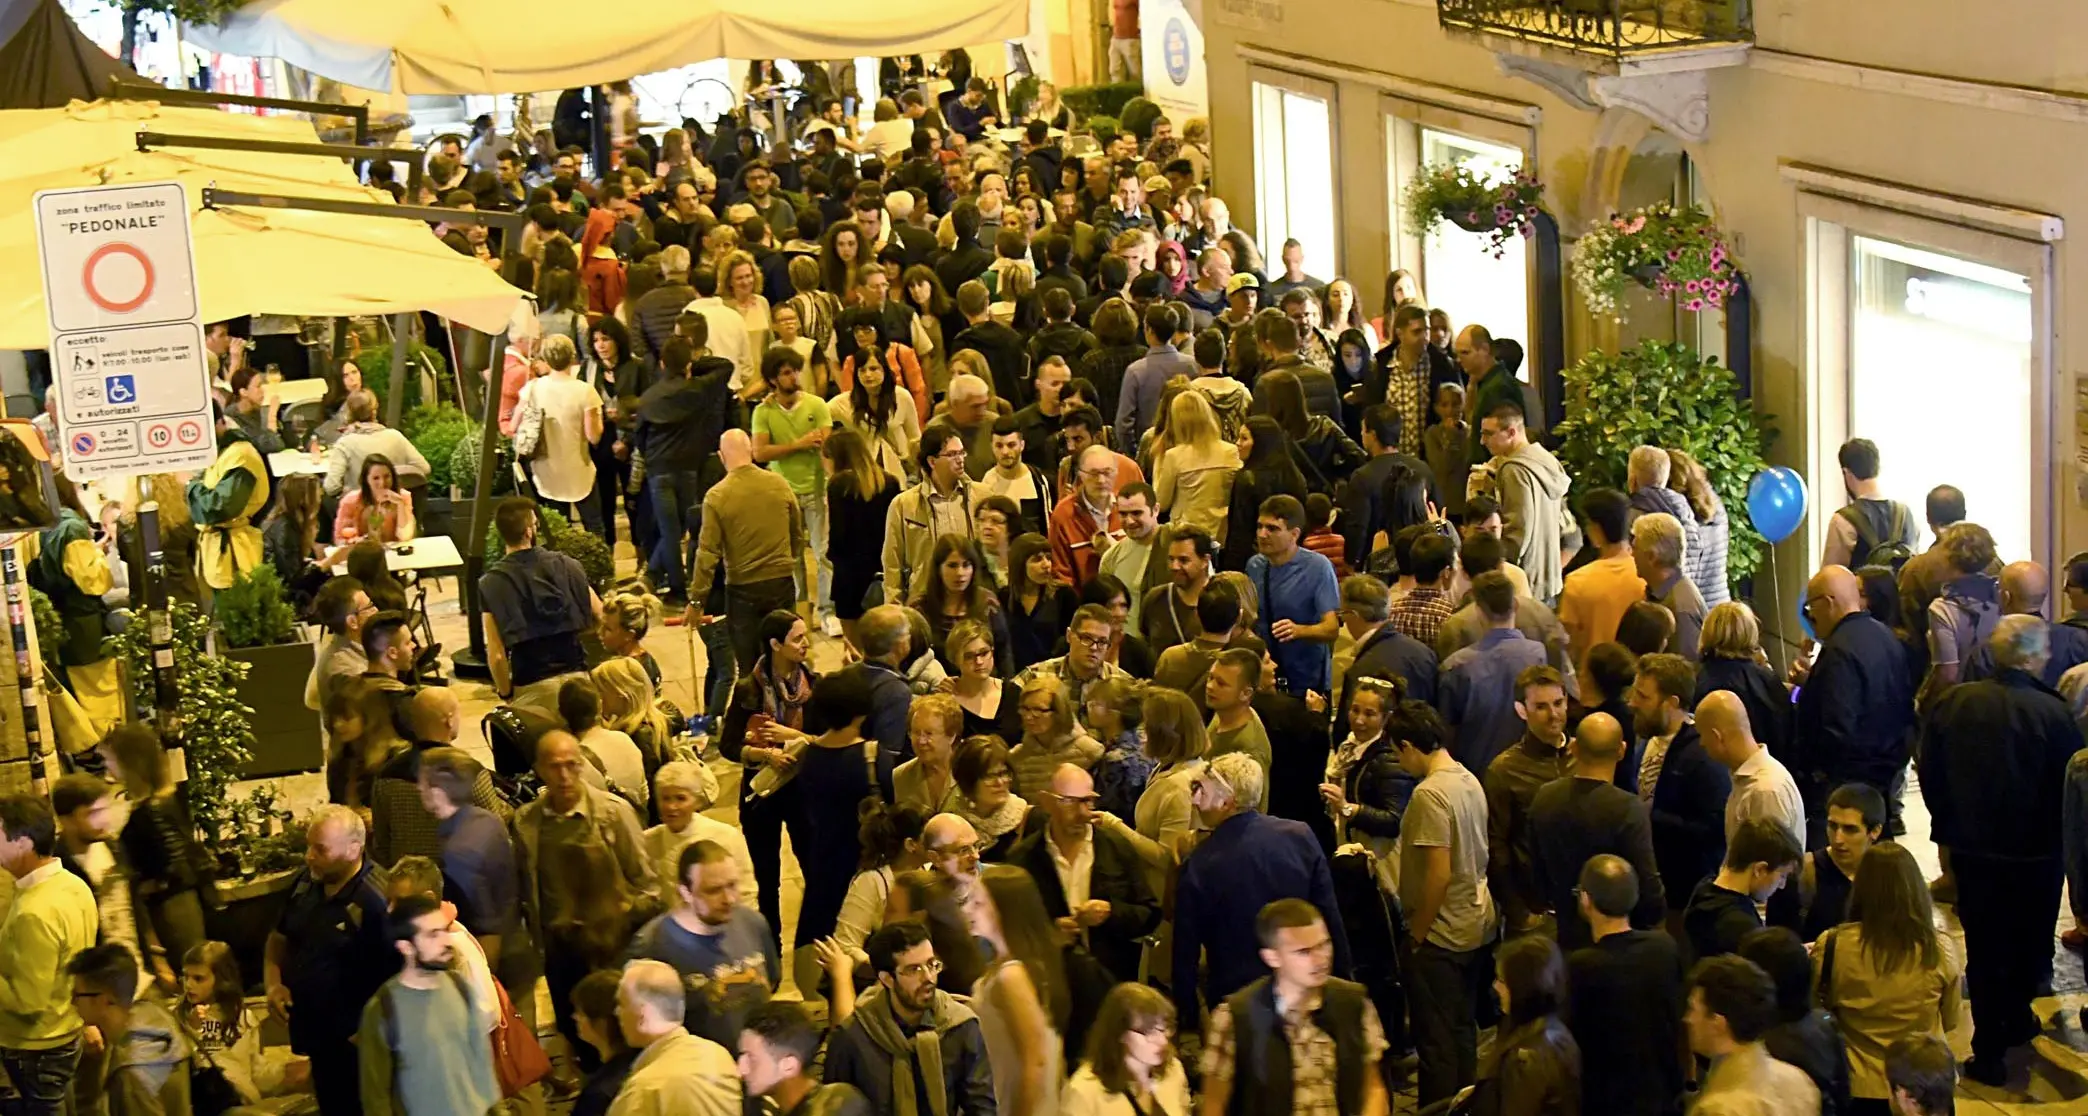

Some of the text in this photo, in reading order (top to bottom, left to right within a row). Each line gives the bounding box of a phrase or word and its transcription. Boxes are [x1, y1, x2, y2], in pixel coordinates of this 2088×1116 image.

[84, 203, 121, 213] traffico
[126, 199, 165, 209] limitato
[87, 405, 140, 417] autorizzati
[154, 431, 166, 441] 10
